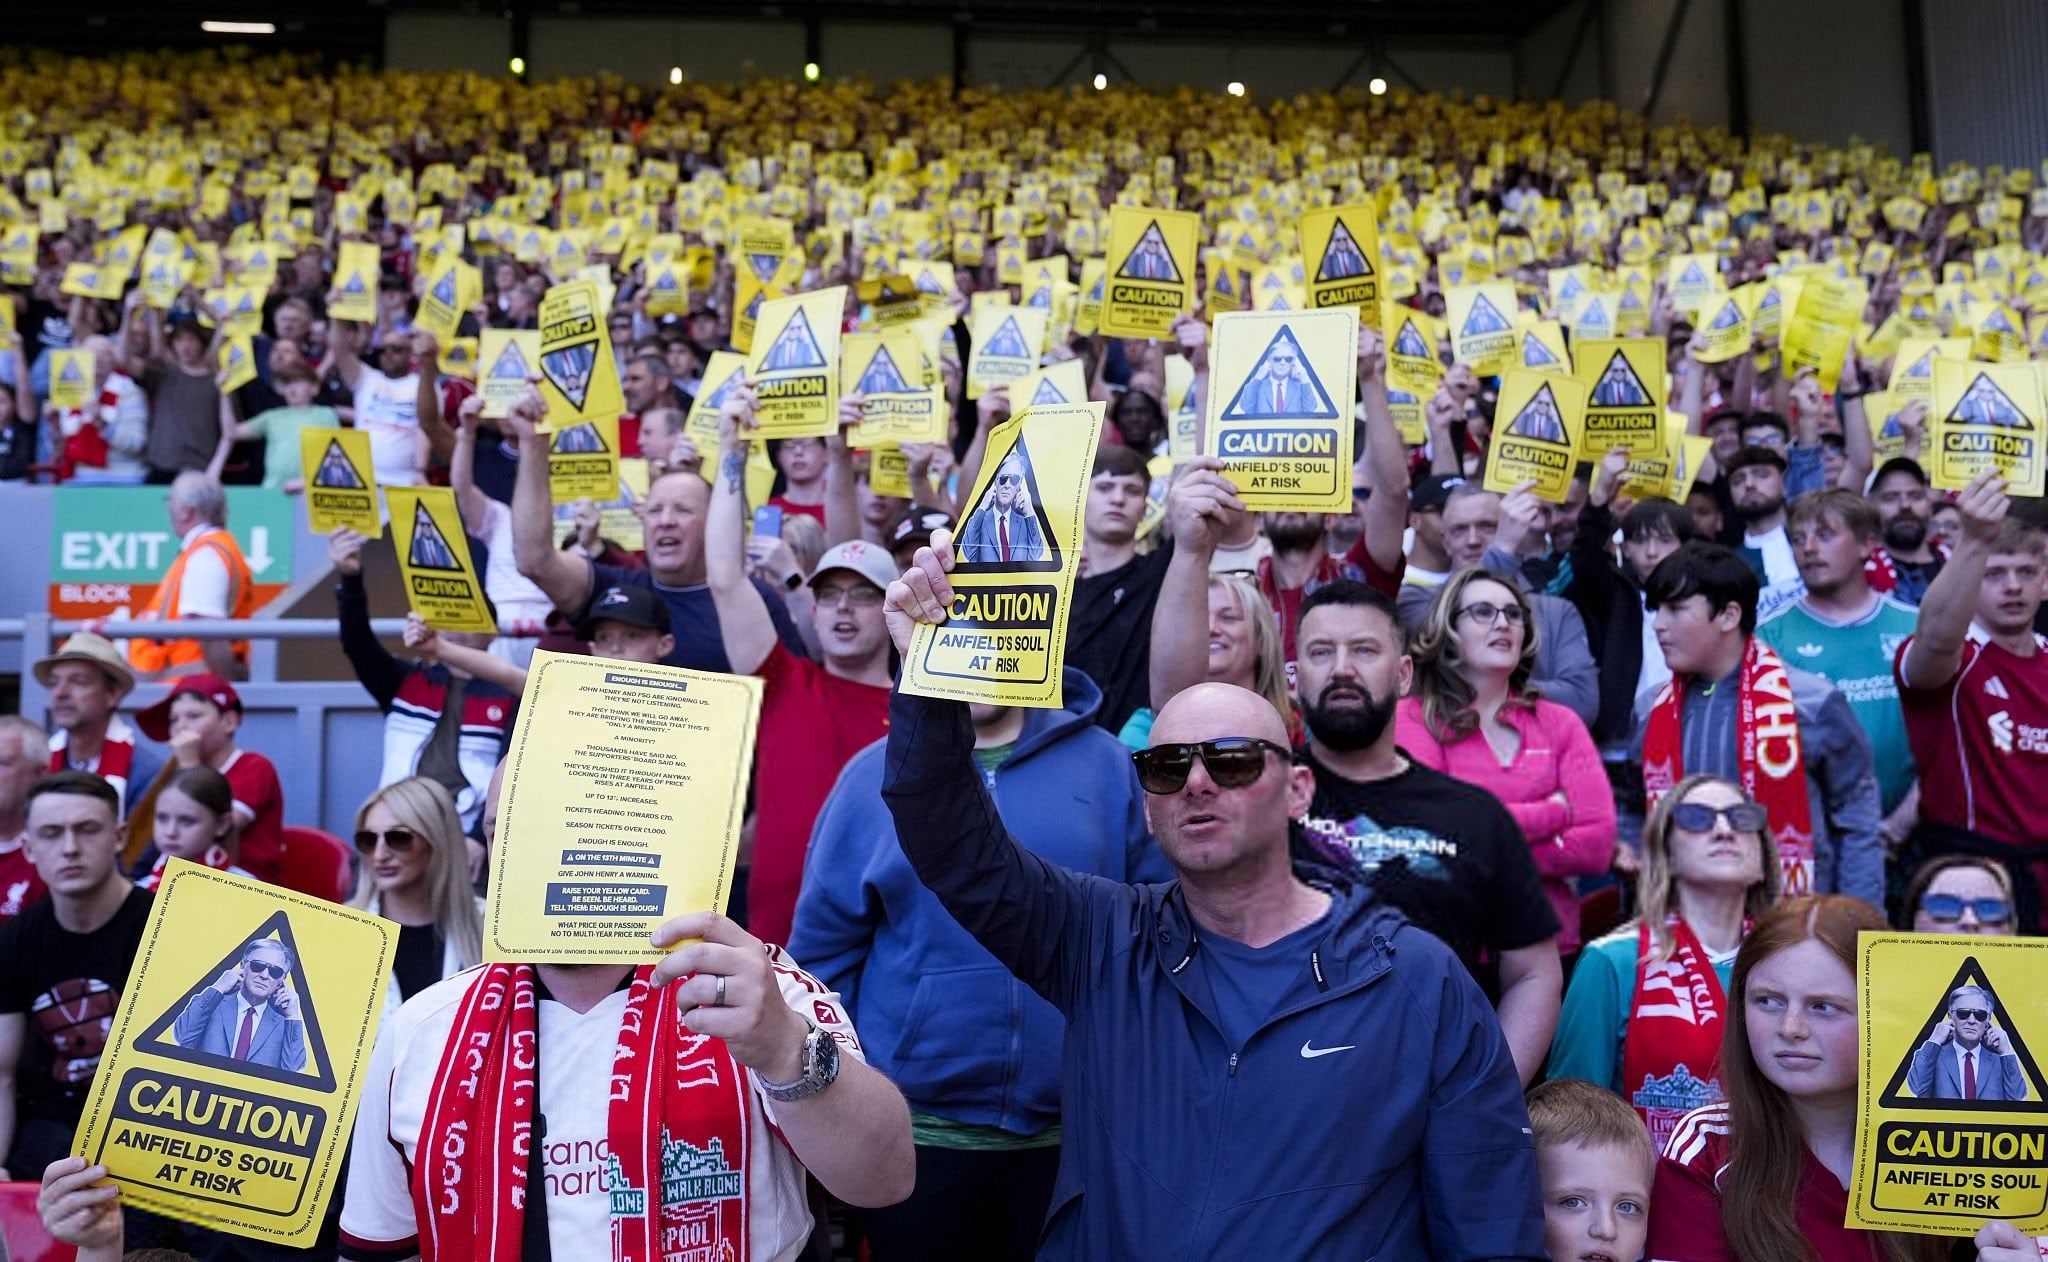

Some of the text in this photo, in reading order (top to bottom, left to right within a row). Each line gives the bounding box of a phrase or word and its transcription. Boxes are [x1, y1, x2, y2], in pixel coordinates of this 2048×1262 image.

[1115, 287, 1180, 306] CAUTION
[1318, 284, 1373, 306] CAUTION
[1588, 415, 1652, 429] CAUTION
[1224, 433, 1330, 453] CAUTION
[1947, 433, 2028, 456] CAUTION
[1502, 444, 1566, 468] CAUTION
[1295, 463, 1329, 473] SOUL
[1251, 478, 1300, 488] AT RISK
[62, 532, 169, 570] EXIT
[60, 584, 131, 602] BLOCK
[415, 578, 469, 597] CAUTION
[948, 593, 1049, 621] CAUTION
[1015, 636, 1044, 651] SOUL
[969, 656, 1019, 673] AT RISK
[610, 676, 640, 685] ENOUGH
[598, 688, 620, 696] HENRY
[665, 695, 698, 704] IGNORING
[609, 708, 630, 716] THINK
[646, 700, 681, 709] LISTENING.
[599, 714, 630, 723] BRIEFING
[645, 719, 667, 727] MEDIA
[620, 735, 655, 745] MINORITY?
[586, 744, 628, 754] THOUSANDS
[632, 756, 656, 764] BOARD
[568, 770, 599, 779] LOCKING
[591, 765, 619, 774] PUSHED
[628, 769, 661, 778] THROUGH
[662, 772, 692, 781] ANYWAY.
[624, 782, 654, 791] ANFIELD.
[619, 796, 659, 805] INCREASES.
[592, 809, 625, 817] HEADING
[626, 812, 659, 820] TOWARDS
[228, 880, 246, 889] POUND
[264, 890, 286, 900] GROUND
[129, 1080, 314, 1146] CAUTION
[1887, 1129, 2044, 1160] CAUTION
[238, 1154, 297, 1181] SOUL
[156, 1164, 246, 1195] AT RISK
[1991, 1174, 2041, 1188] SOUL
[667, 1175, 740, 1201] WALK ALONE
[610, 1192, 642, 1212] LONE
[1924, 1193, 2000, 1210] AT RISK
